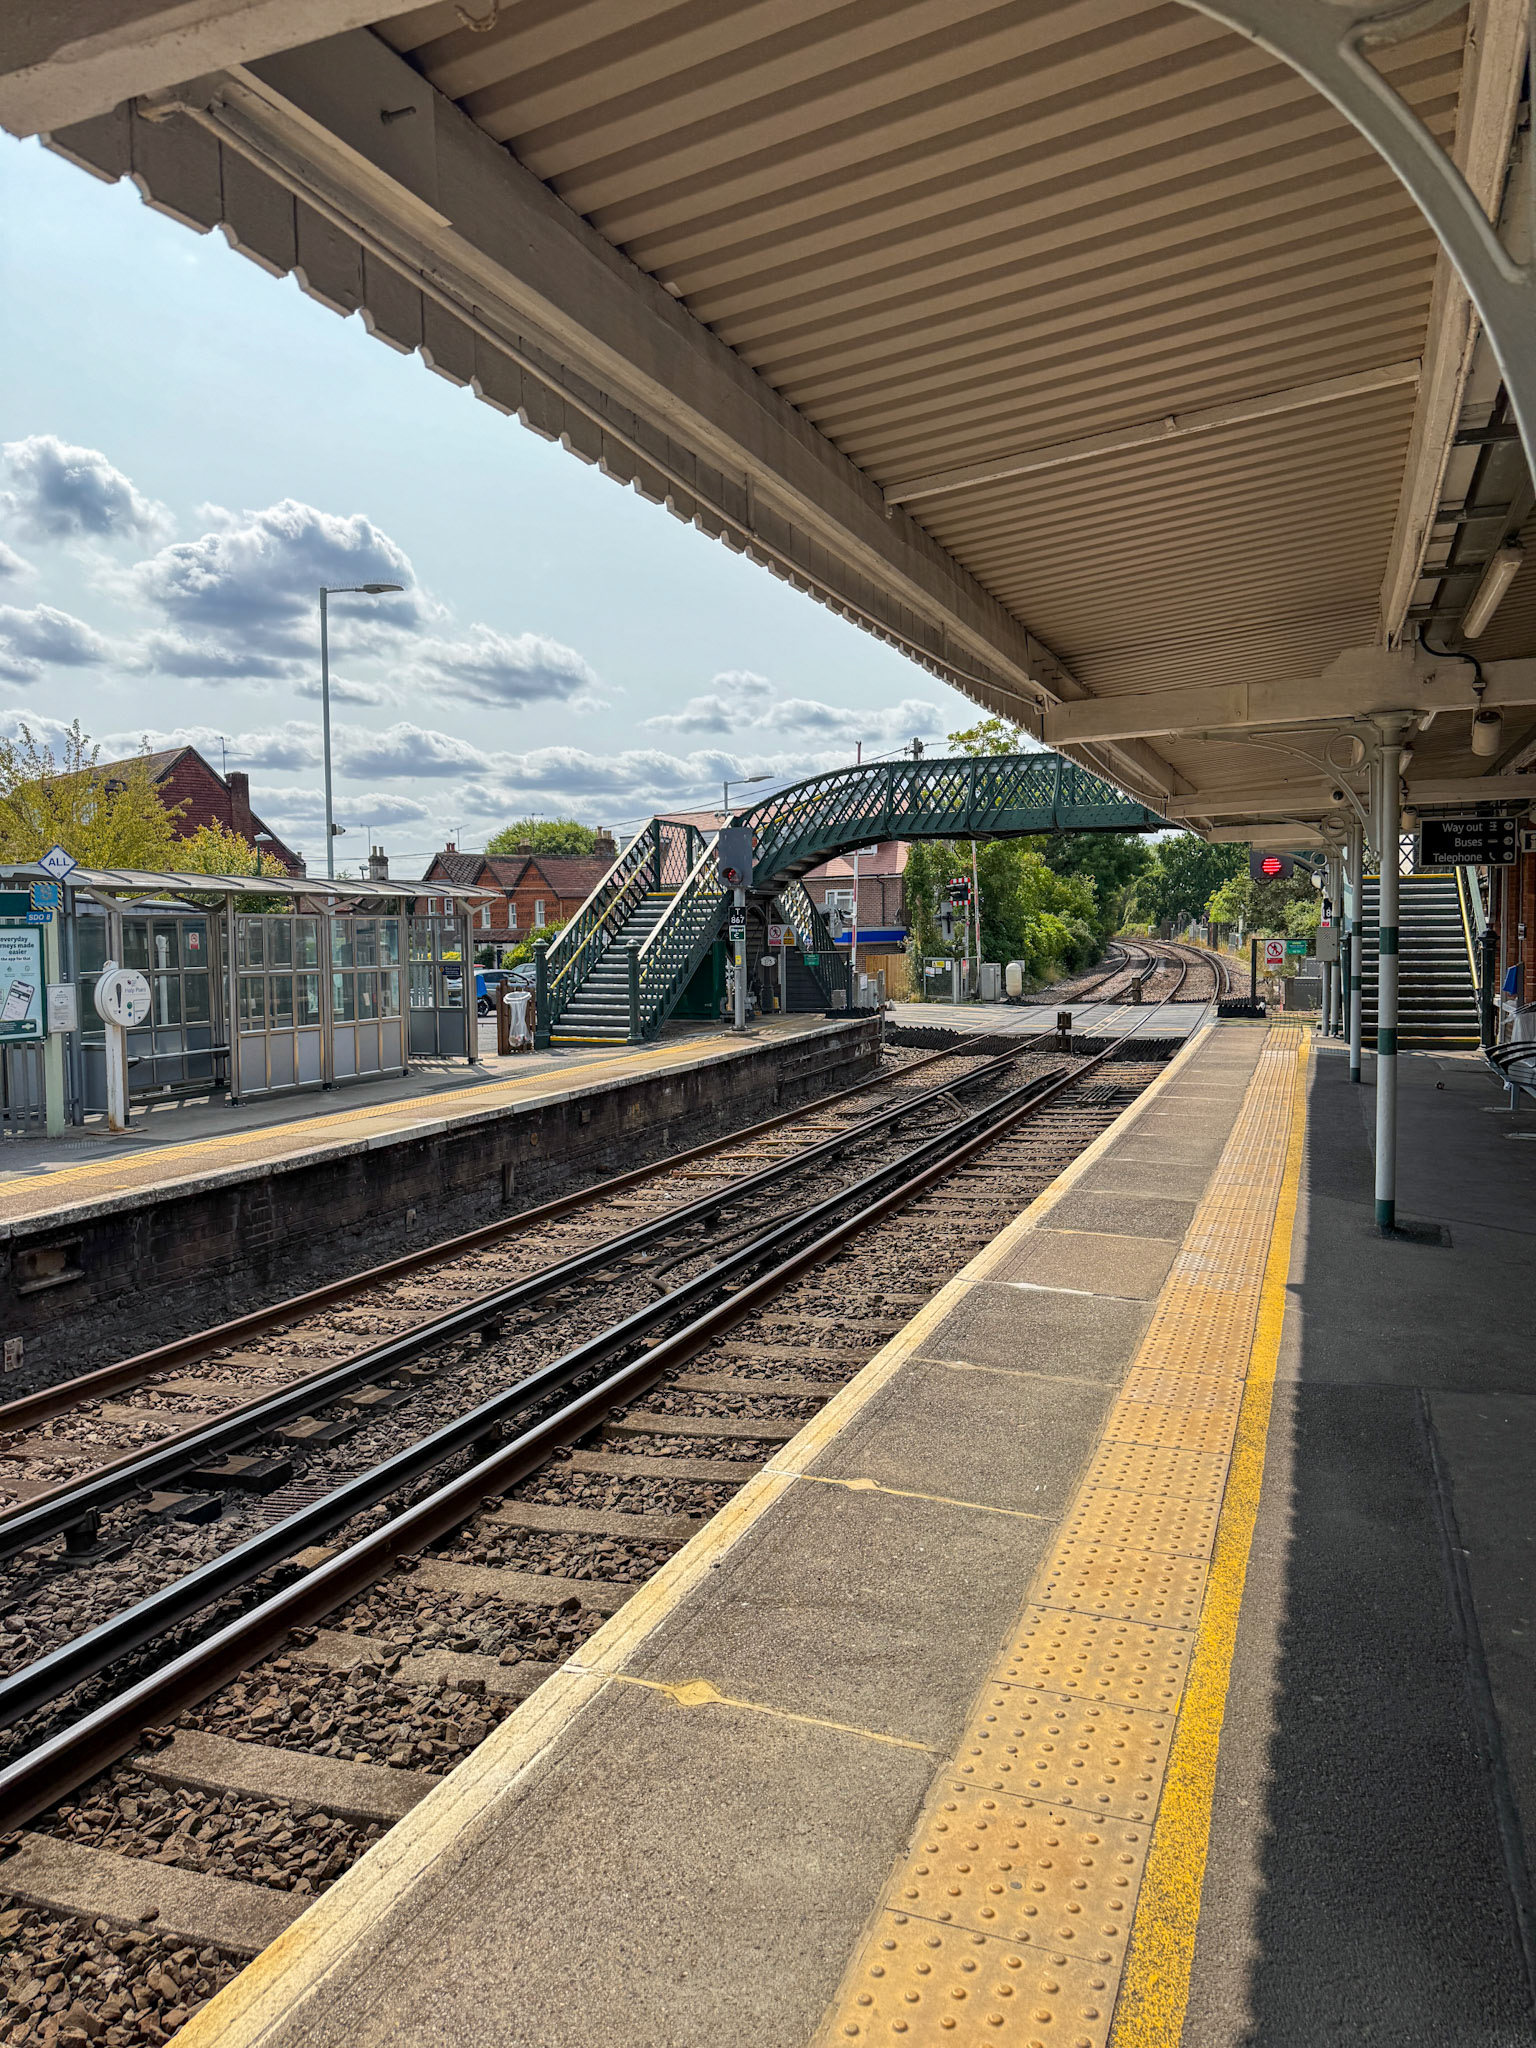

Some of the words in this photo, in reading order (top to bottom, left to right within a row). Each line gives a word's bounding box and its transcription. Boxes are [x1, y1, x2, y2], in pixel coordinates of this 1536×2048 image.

[1442, 823, 1464, 834] Way
[1466, 823, 1483, 832] out
[1454, 838, 1482, 847] Buses
[48, 858, 70, 866] ALL
[1433, 852, 1482, 864] Telephone
[731, 916, 744, 924] 867
